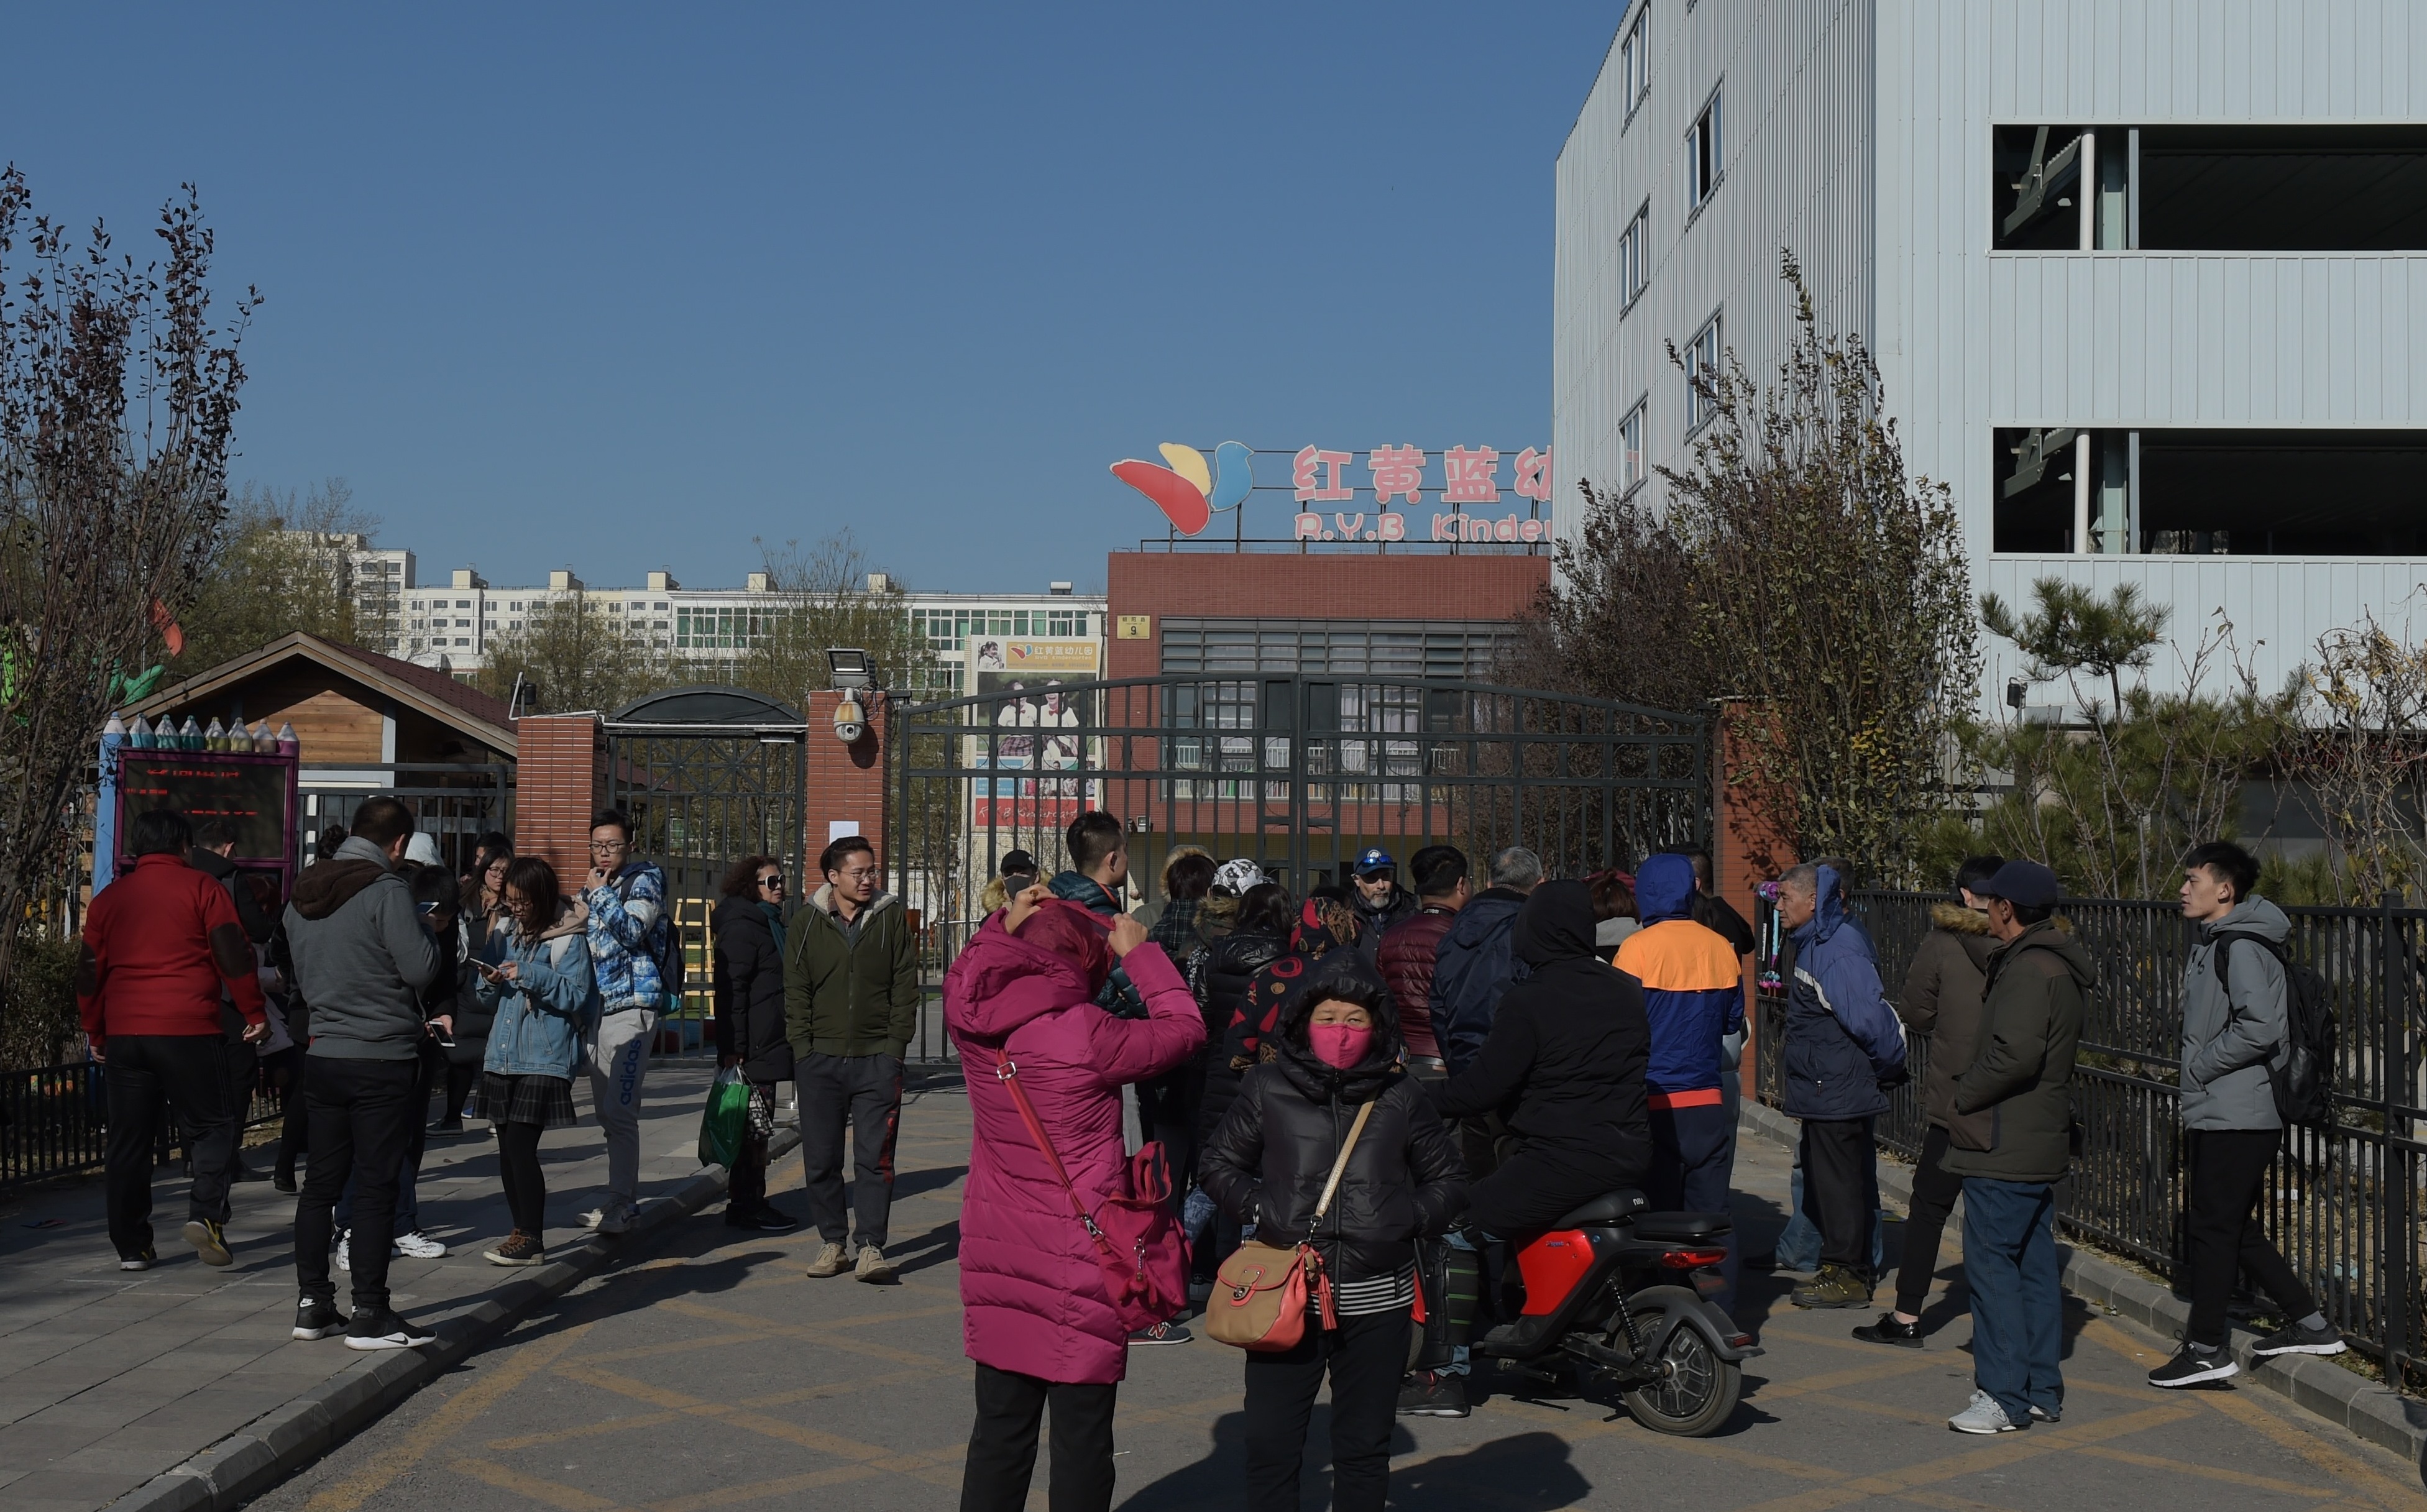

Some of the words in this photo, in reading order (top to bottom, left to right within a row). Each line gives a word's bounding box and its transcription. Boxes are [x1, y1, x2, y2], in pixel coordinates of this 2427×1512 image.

[1295, 513, 1405, 541] R.Y.B
[1131, 626, 1137, 635] 9
[1034, 646, 1093, 656] 红黄蓝幼儿园
[619, 1039, 642, 1106] adidas
